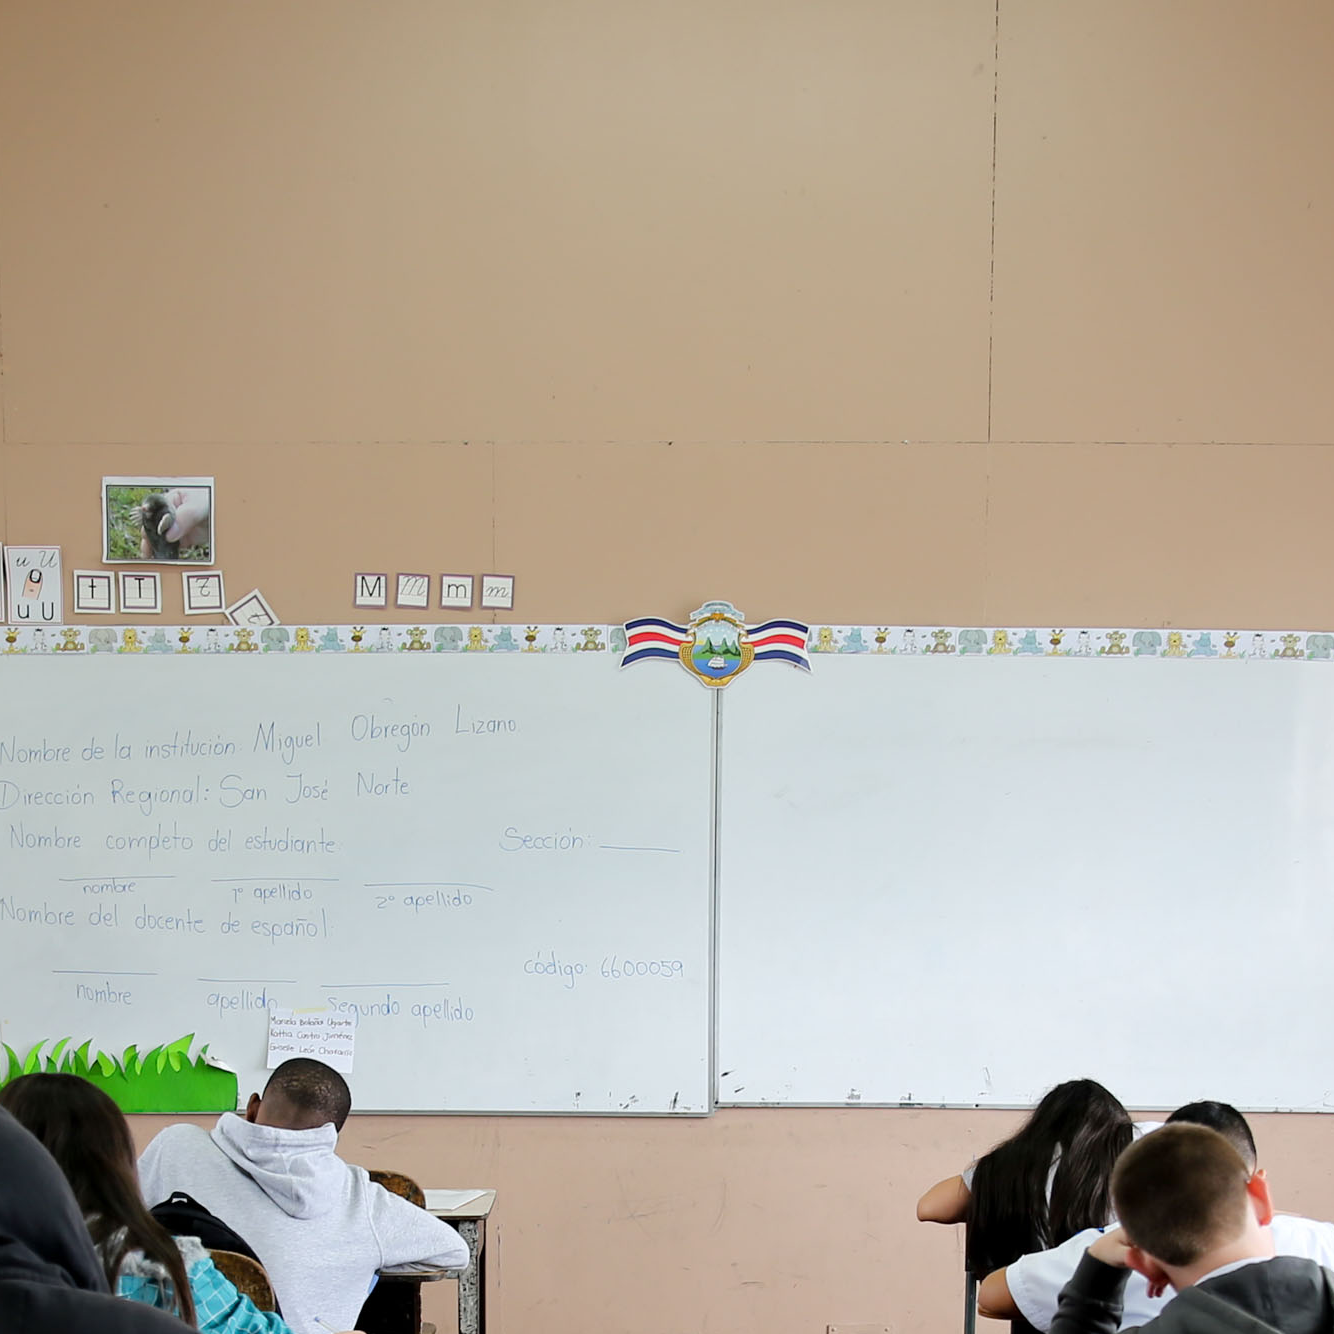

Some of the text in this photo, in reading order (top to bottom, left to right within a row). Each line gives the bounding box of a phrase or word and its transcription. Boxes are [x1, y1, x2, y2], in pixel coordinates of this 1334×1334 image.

[361, 576, 381, 598] M
[447, 583, 467, 598] m
[0, 736, 71, 765] Nombre
[81, 736, 105, 762] de
[115, 732, 131, 760] la
[253, 722, 321, 765] Miguel
[455, 704, 517, 735] Lizano
[111, 774, 209, 816] Regional:
[219, 774, 267, 808] San
[285, 773, 329, 804] José
[357, 767, 410, 797] Norte
[10, 821, 82, 850] Nombre
[105, 820, 194, 862] completo
[208, 828, 232, 852] del
[83, 877, 137, 895] nombre
[253, 882, 313, 905] apellido
[1, 896, 75, 926] Nombre
[89, 903, 119, 928] del
[135, 904, 206, 934] docente
[221, 912, 241, 934] de
[403, 889, 473, 914] apellido
[76, 981, 131, 1006] nombre
[207, 988, 278, 1018] apellido
[411, 997, 474, 1028] apellido
